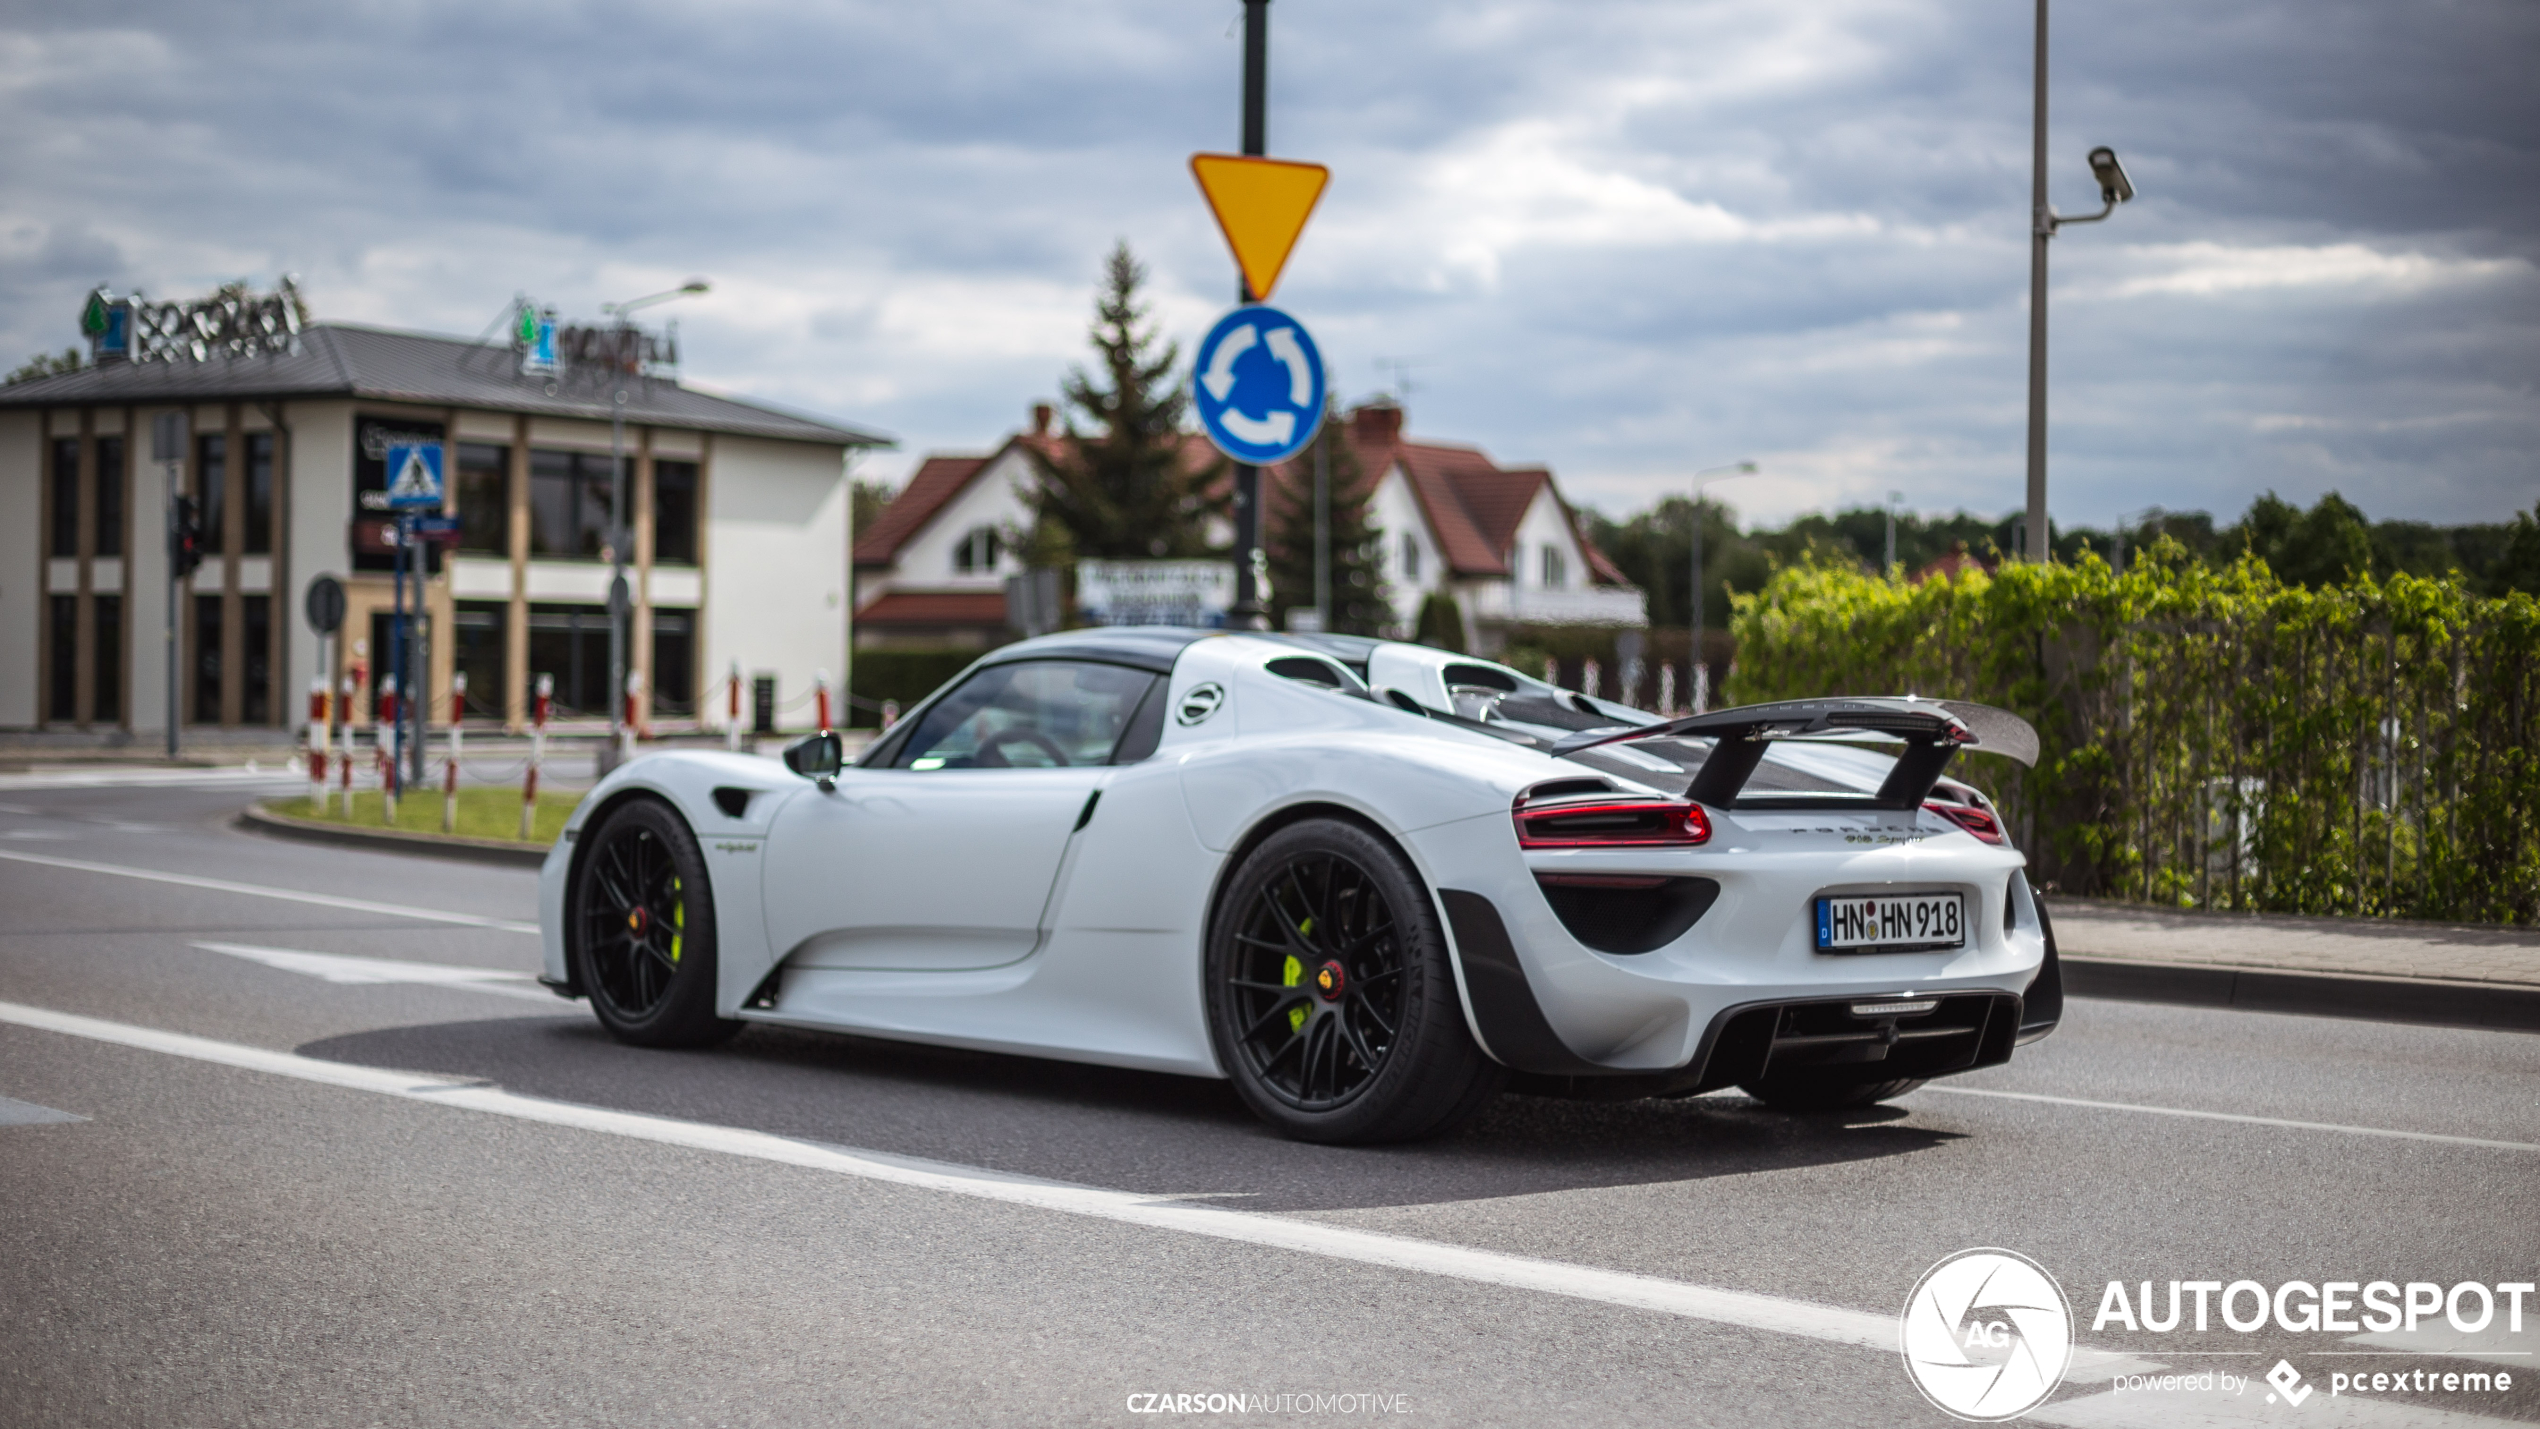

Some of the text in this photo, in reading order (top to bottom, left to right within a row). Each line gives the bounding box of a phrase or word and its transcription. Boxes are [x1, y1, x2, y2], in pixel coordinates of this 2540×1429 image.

[1821, 927, 1828, 939] D
[1833, 900, 1959, 940] HN HN 918
